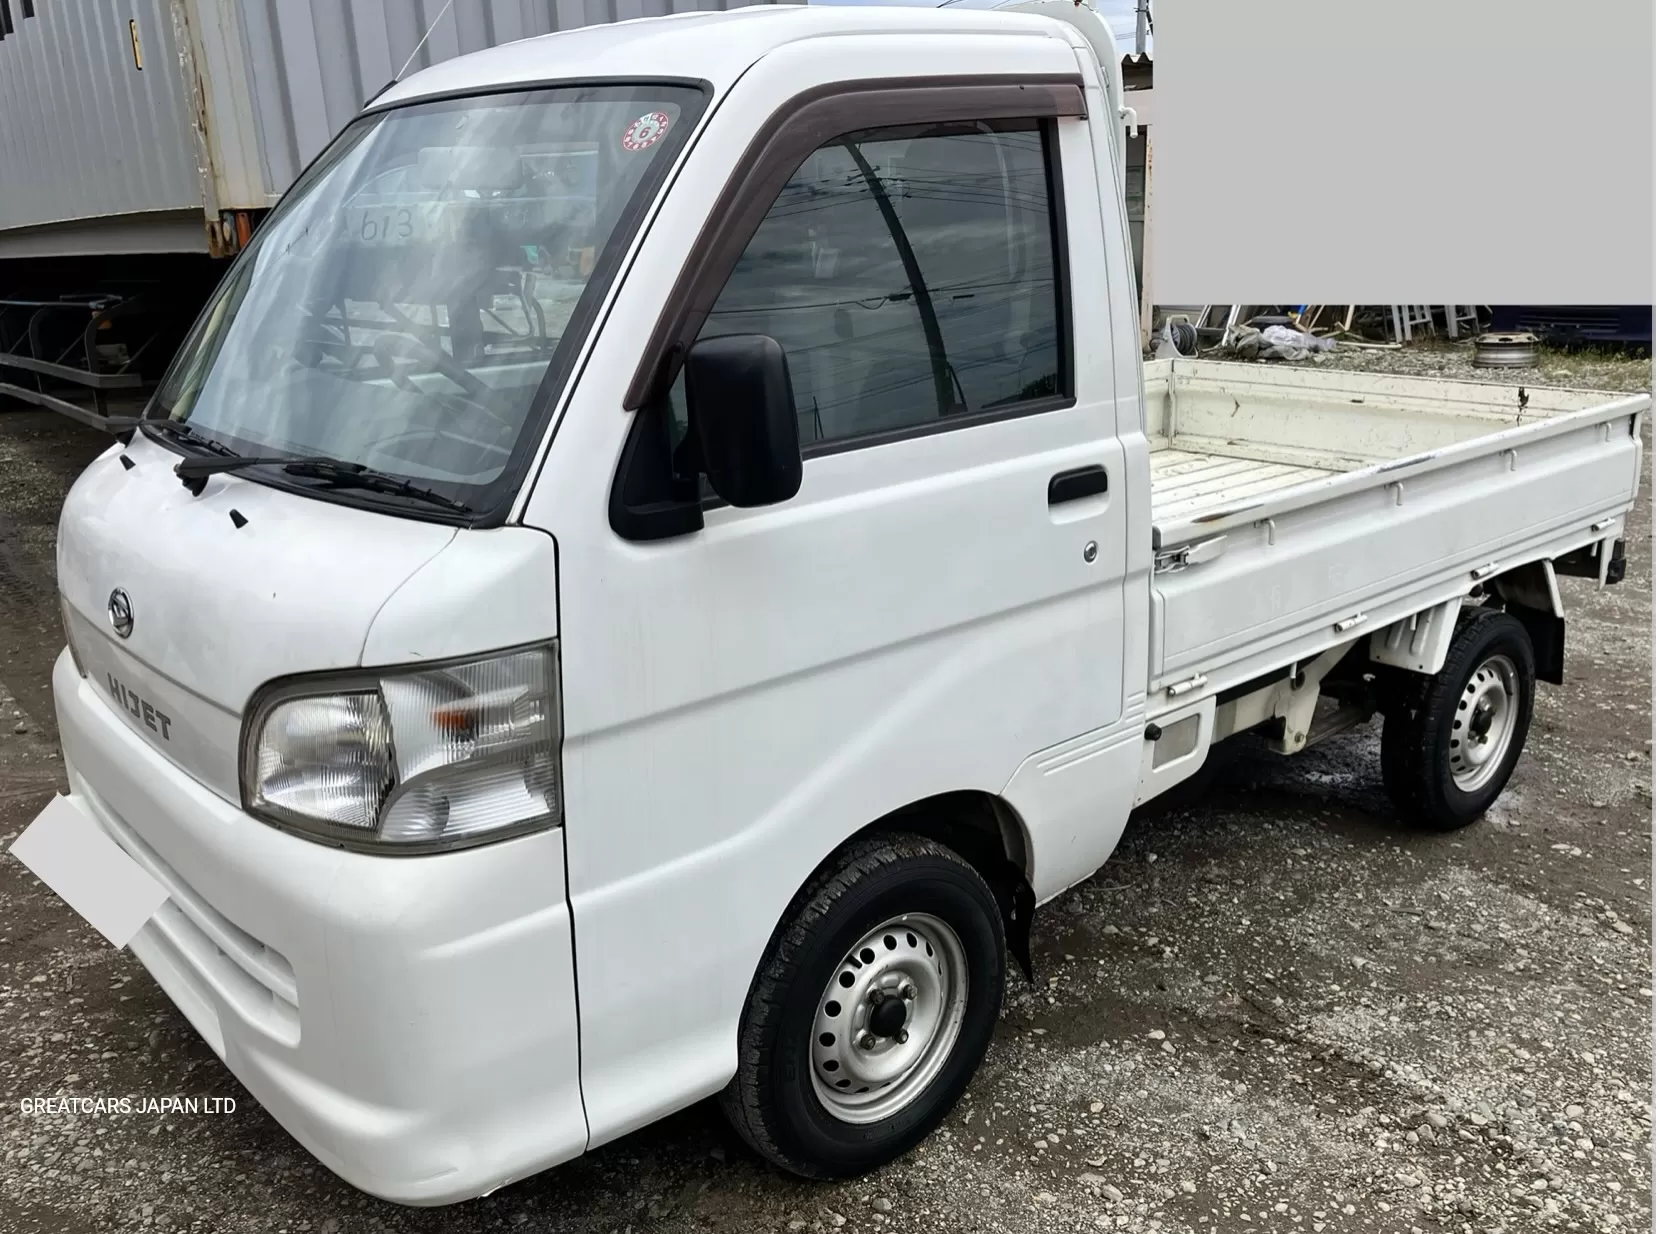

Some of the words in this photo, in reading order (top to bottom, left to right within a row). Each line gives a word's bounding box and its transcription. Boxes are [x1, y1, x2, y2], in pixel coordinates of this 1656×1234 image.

[639, 126, 651, 139] 6
[361, 208, 414, 241] 613
[107, 672, 172, 741] HIJET
